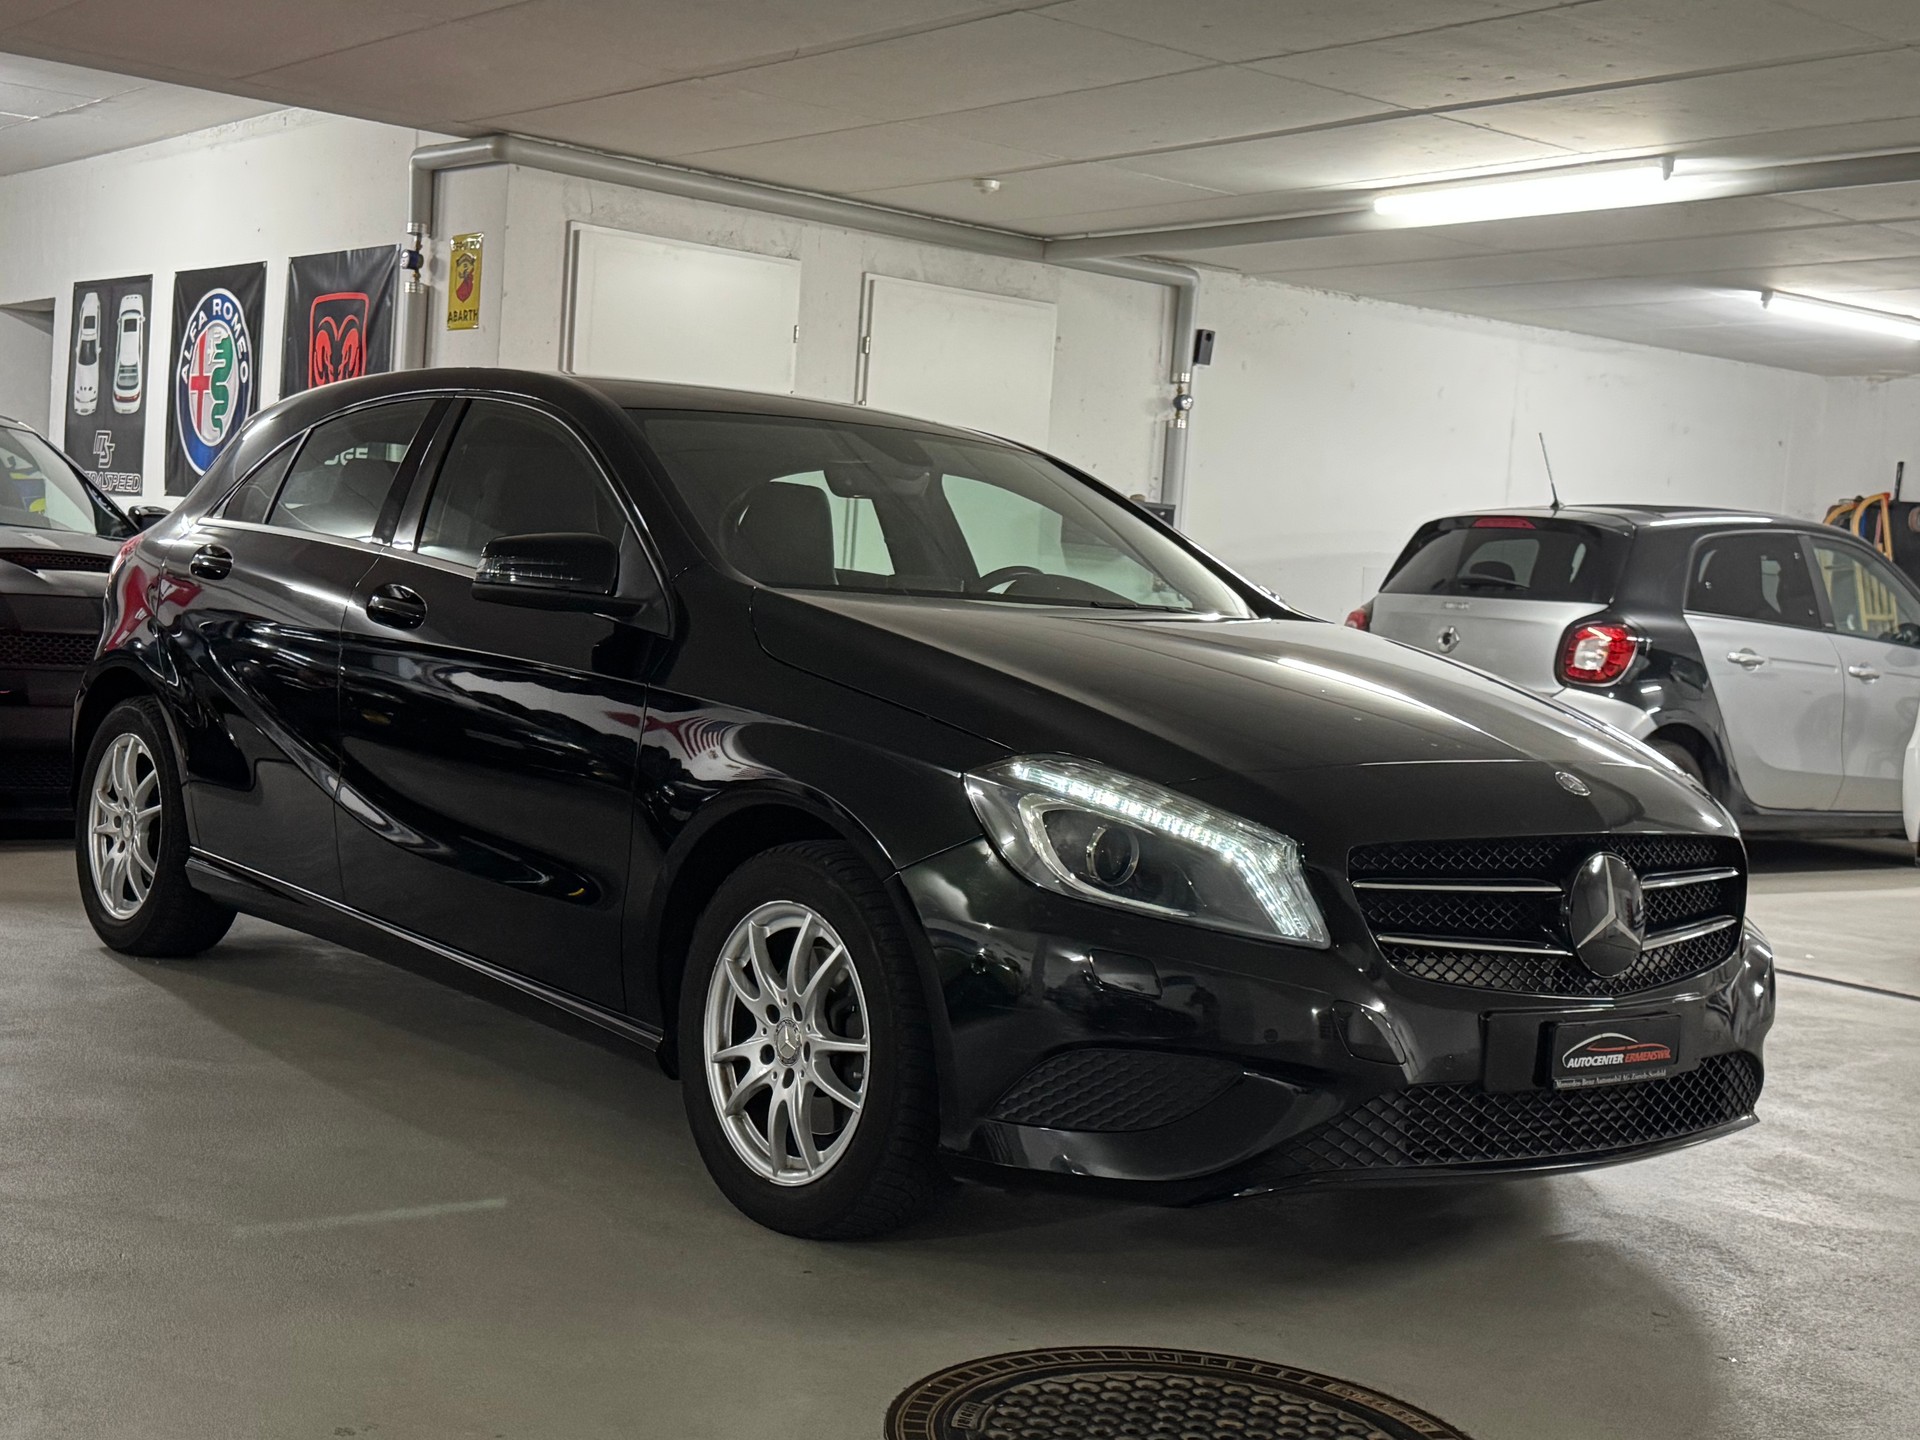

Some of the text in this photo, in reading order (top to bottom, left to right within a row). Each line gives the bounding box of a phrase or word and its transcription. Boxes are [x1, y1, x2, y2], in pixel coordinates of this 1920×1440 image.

[448, 309, 478, 322] ABARTH
[181, 298, 249, 384] ALFA ROMEO
[1567, 1054, 1624, 1068] AUTOCENTER
